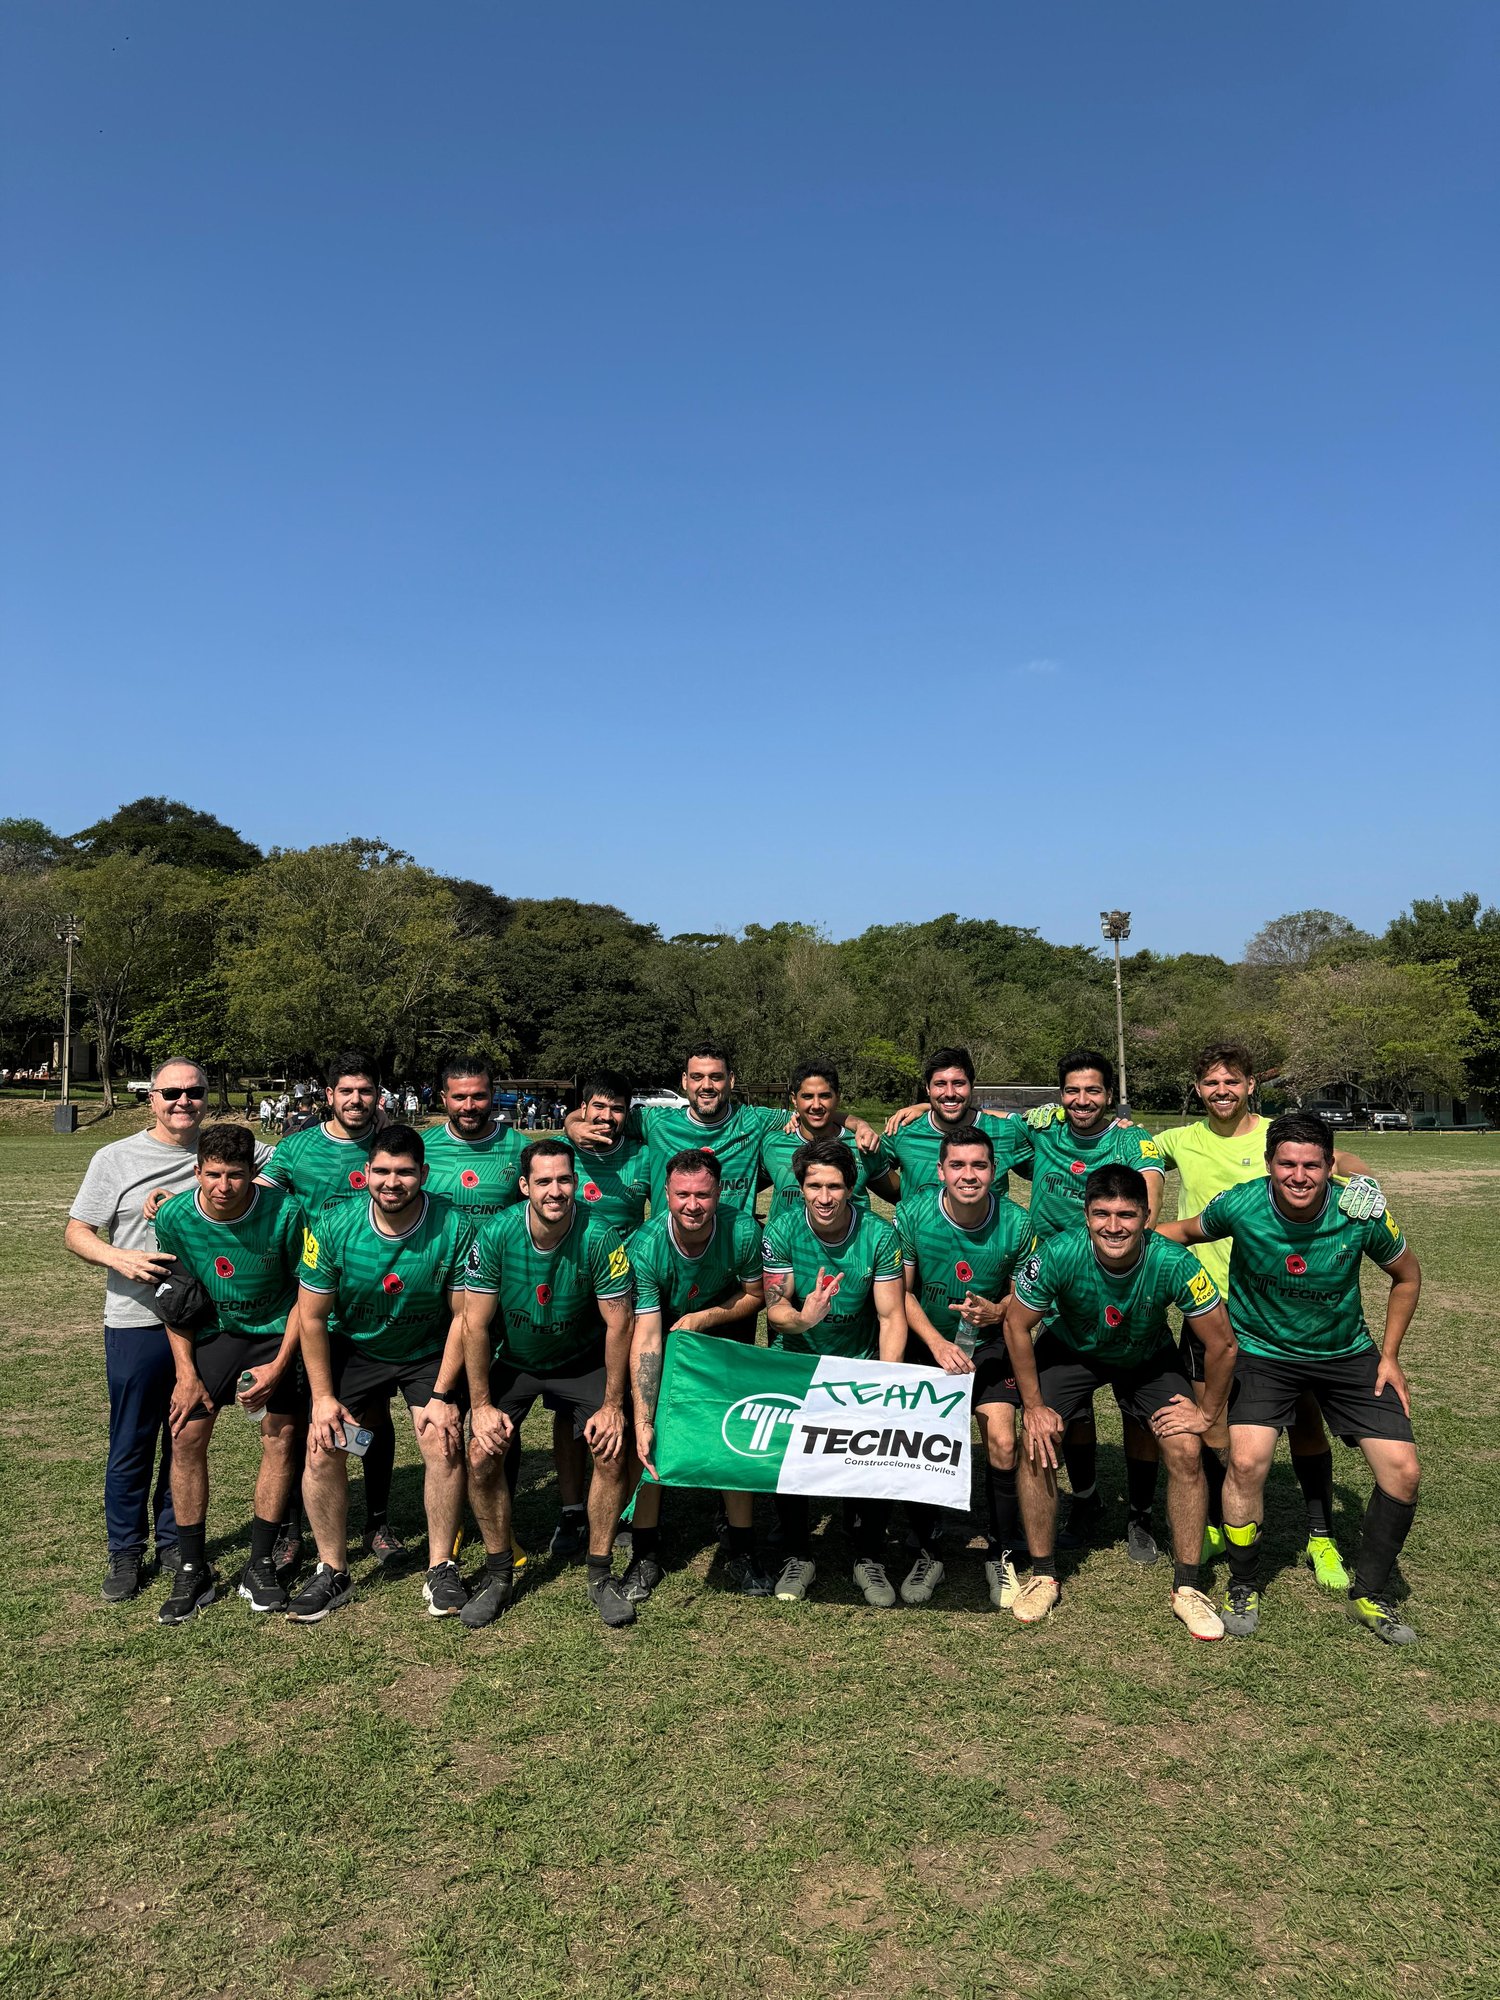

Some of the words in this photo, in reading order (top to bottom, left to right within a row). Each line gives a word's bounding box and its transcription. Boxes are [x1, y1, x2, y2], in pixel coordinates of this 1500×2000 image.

[808, 1381, 966, 1419] TEAM
[801, 1425, 963, 1468] TECINCI
[844, 1457, 922, 1470] Construcciones
[924, 1463, 957, 1476] Civiles
